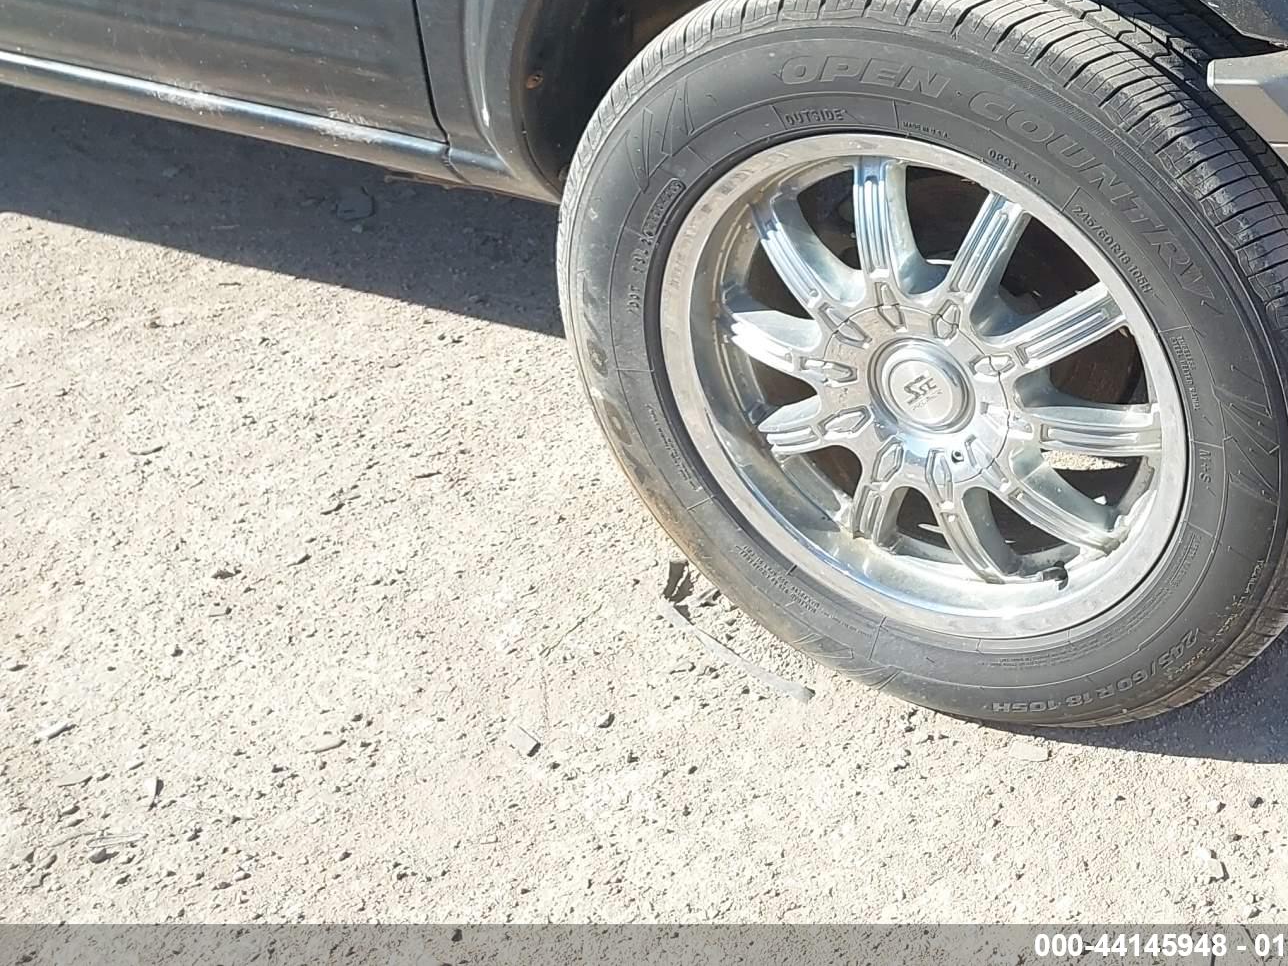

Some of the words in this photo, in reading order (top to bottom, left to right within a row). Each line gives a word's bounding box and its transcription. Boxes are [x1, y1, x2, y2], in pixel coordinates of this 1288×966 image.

[781, 55, 951, 98] OPEN
[967, 90, 1215, 300] COUNTRY
[784, 109, 844, 126] OUTSIDE
